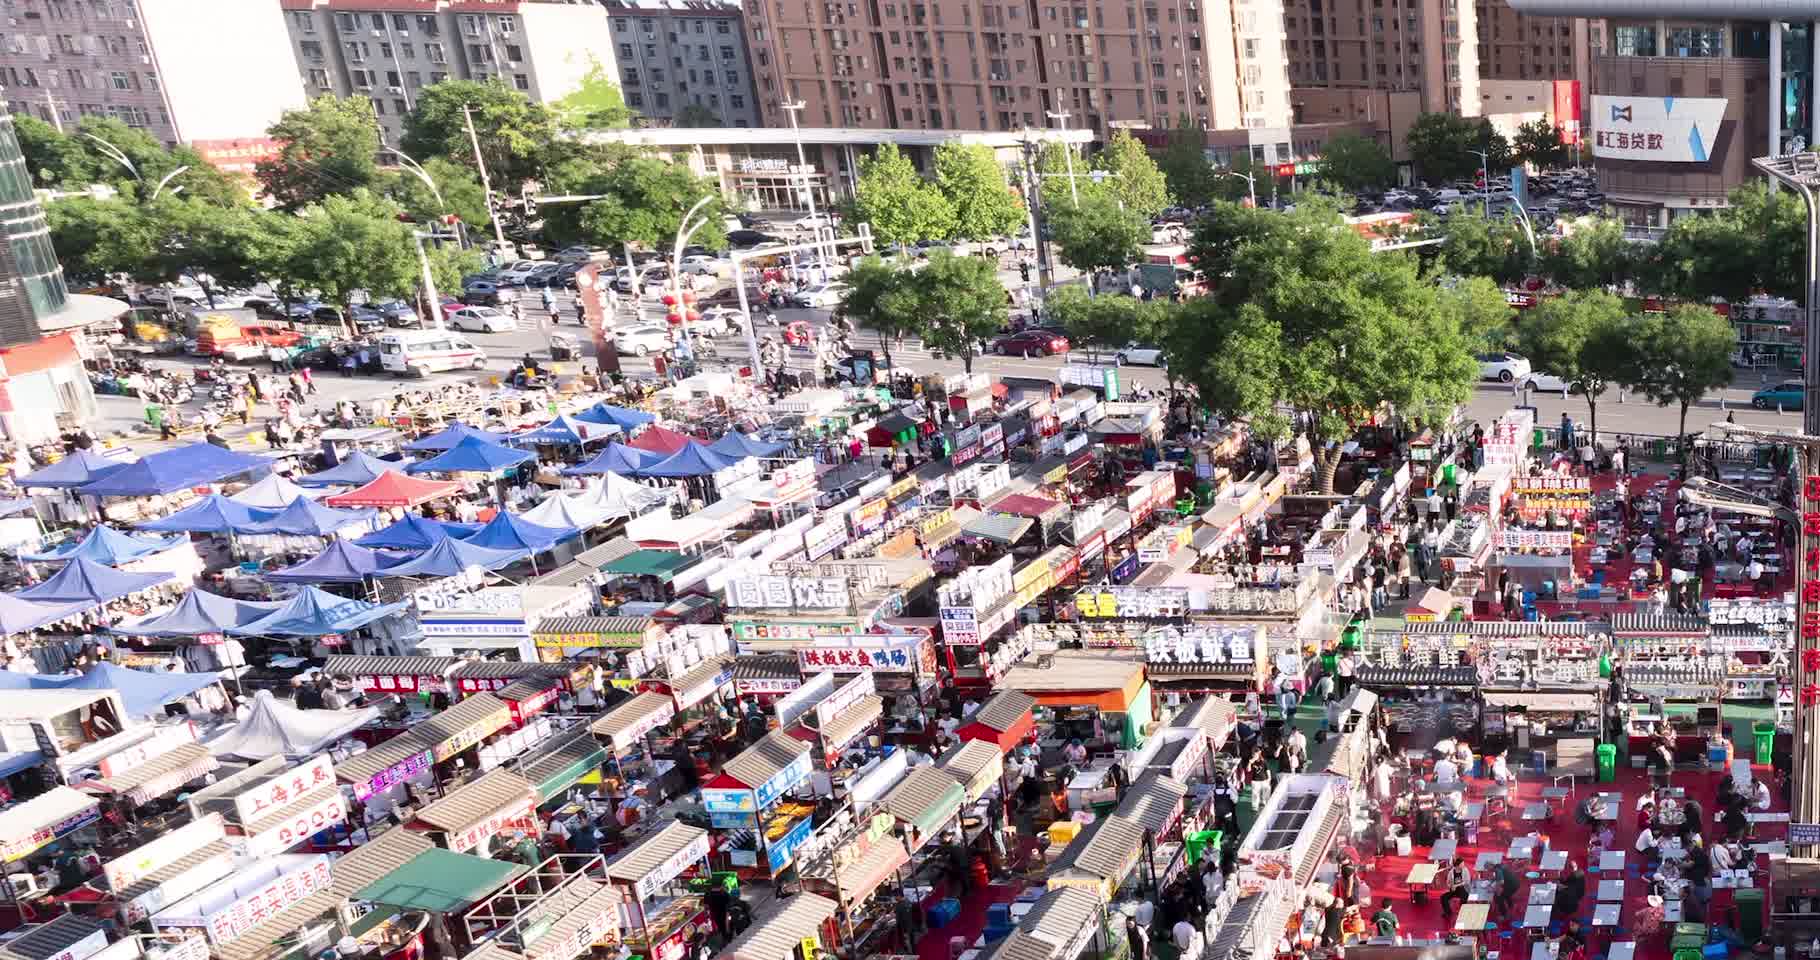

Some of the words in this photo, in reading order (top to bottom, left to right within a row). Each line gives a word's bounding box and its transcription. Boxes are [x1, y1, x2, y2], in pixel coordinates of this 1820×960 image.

[1146, 635, 1254, 664] 铁板鱿鱼
[213, 859, 335, 944] 新疆买买提烤肉
